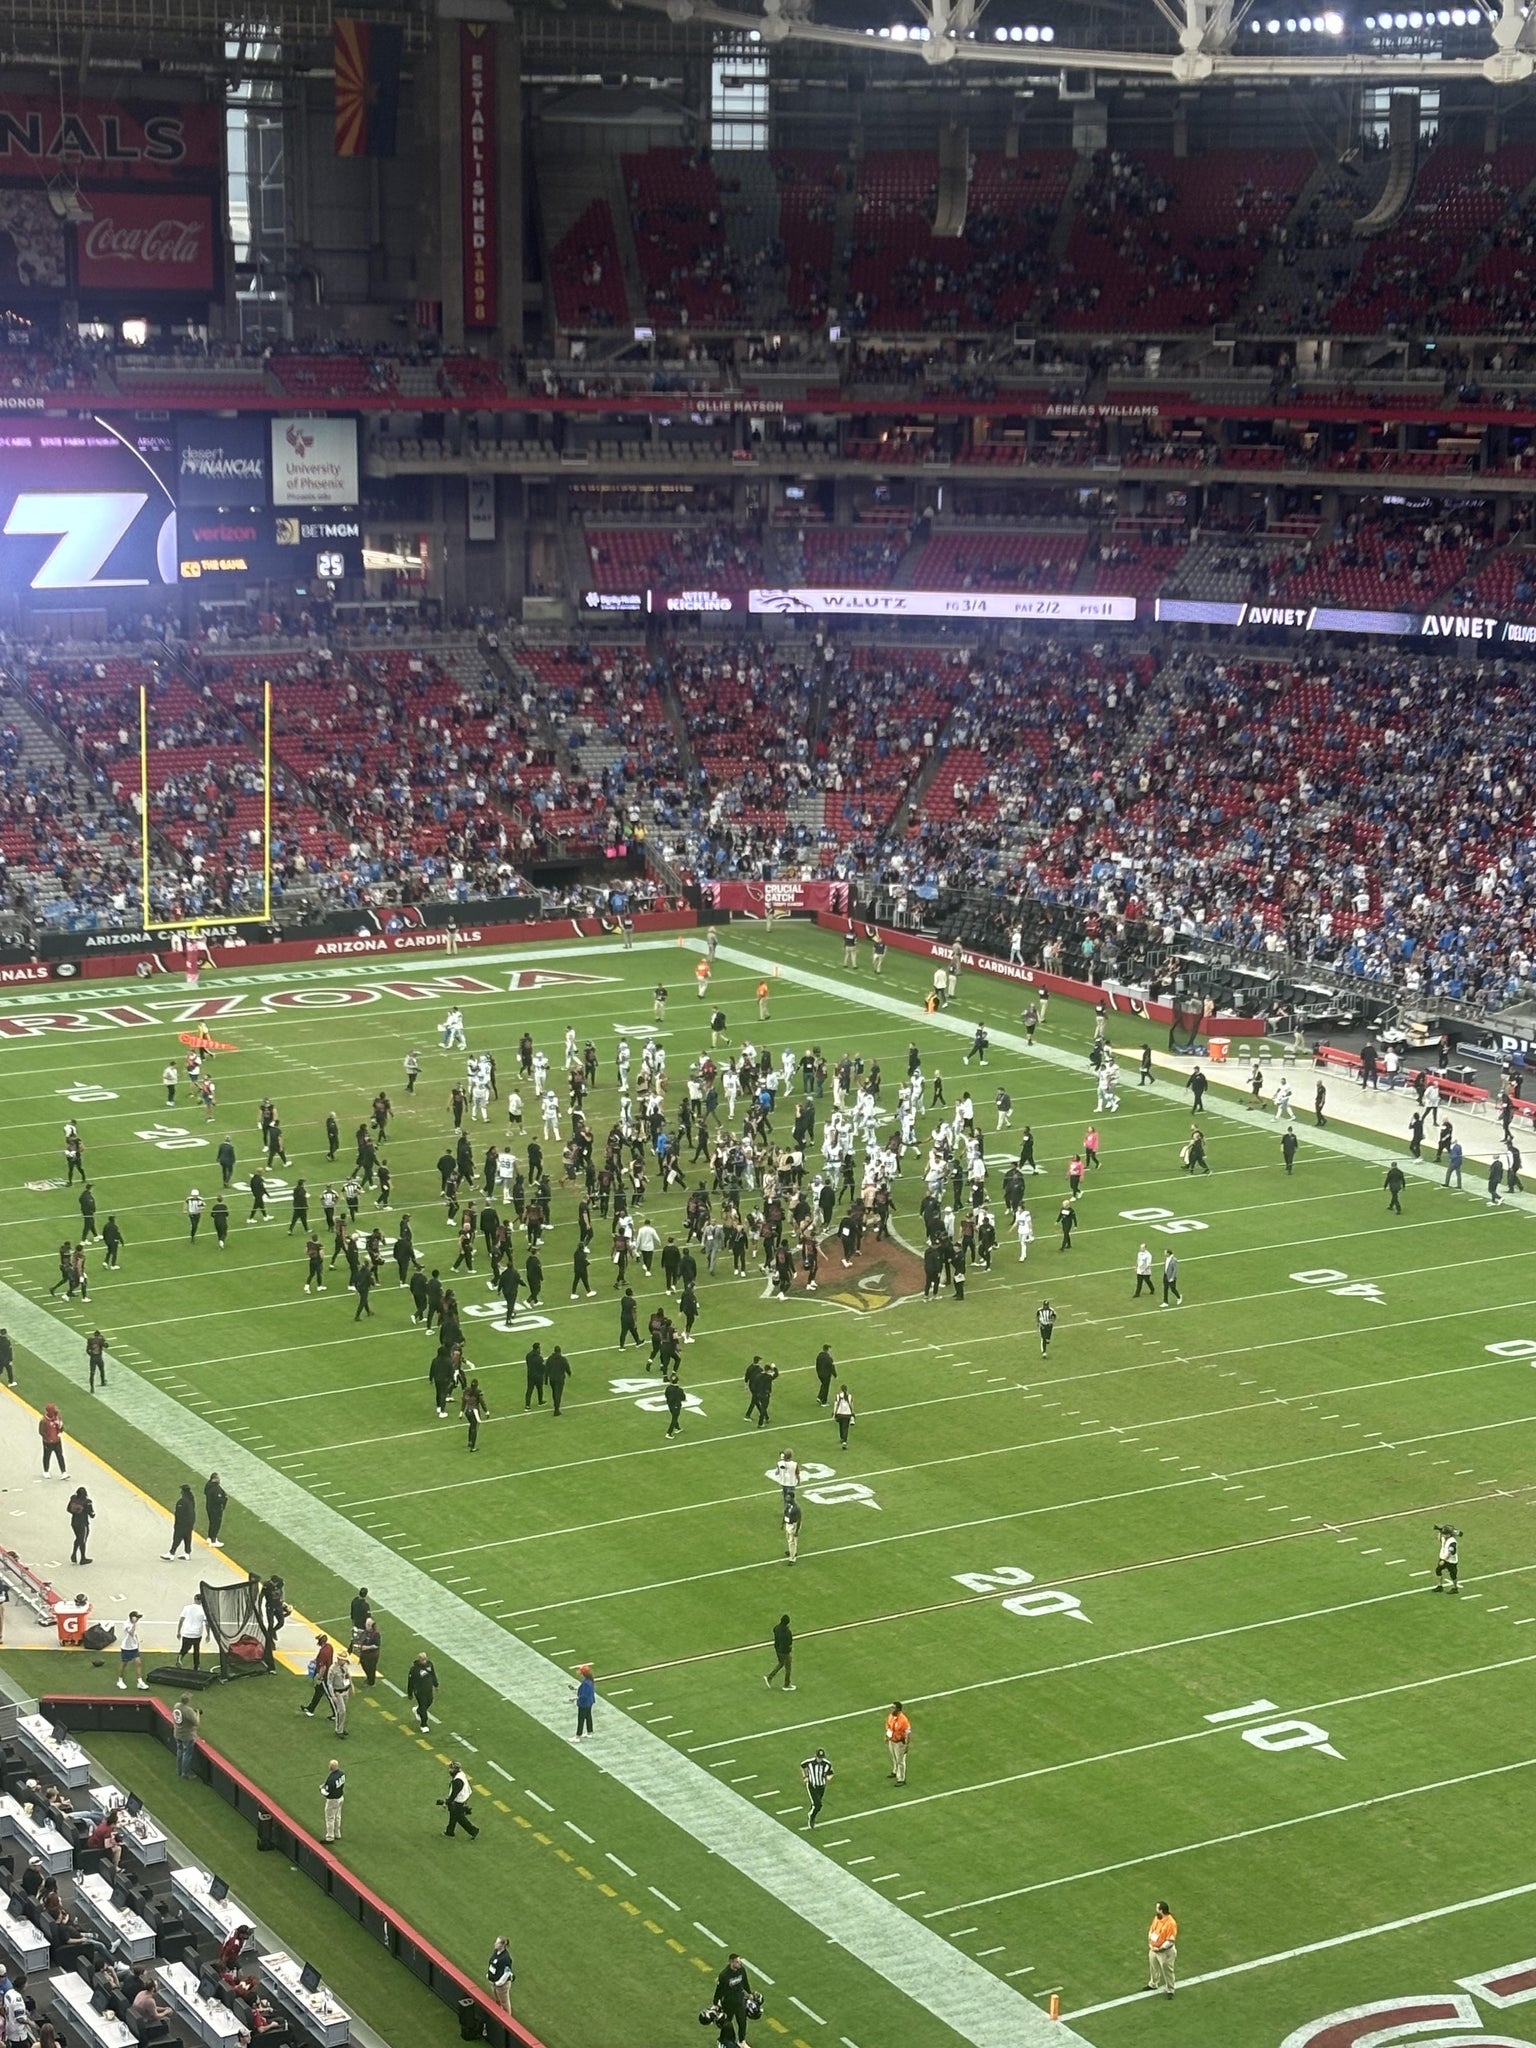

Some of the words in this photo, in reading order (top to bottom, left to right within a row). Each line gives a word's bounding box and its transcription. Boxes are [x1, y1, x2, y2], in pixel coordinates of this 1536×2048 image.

[0, 112, 187, 161] NALS
[471, 54, 485, 249] ESTABLISHED
[85, 217, 202, 262] Coca-Cola
[734, 400, 784, 413] MATSON
[1046, 404, 1096, 416] AENEAS
[1098, 405, 1160, 416] WILLIAMS
[182, 444, 224, 460] desert
[286, 463, 341, 477] University
[286, 480, 301, 490] of
[302, 479, 345, 491] Phoenix
[193, 522, 257, 542] verizon
[301, 523, 359, 538] BETMGM
[823, 596, 907, 609] W.LUTZ
[962, 601, 987, 612] 3/4
[1036, 602, 1061, 613] 2/2
[1248, 606, 1308, 626] AVNET
[1421, 615, 1498, 639] AVNET
[764, 884, 804, 893] CRUCIAL
[764, 894, 795, 902] CATCH
[85, 933, 152, 947] ARIZONA
[315, 939, 388, 955] ARIZONA
[931, 944, 974, 966] ARIZNA
[978, 957, 1034, 983] CARDINALS
[54, 1081, 120, 1103] 10
[133, 1123, 210, 1150] 20
[1118, 1207, 1209, 1234] 50
[1289, 1269, 1388, 1305] 40
[950, 1566, 1094, 1625] 20
[63, 1618, 79, 1633] G
[1203, 1699, 1348, 1761] 10
